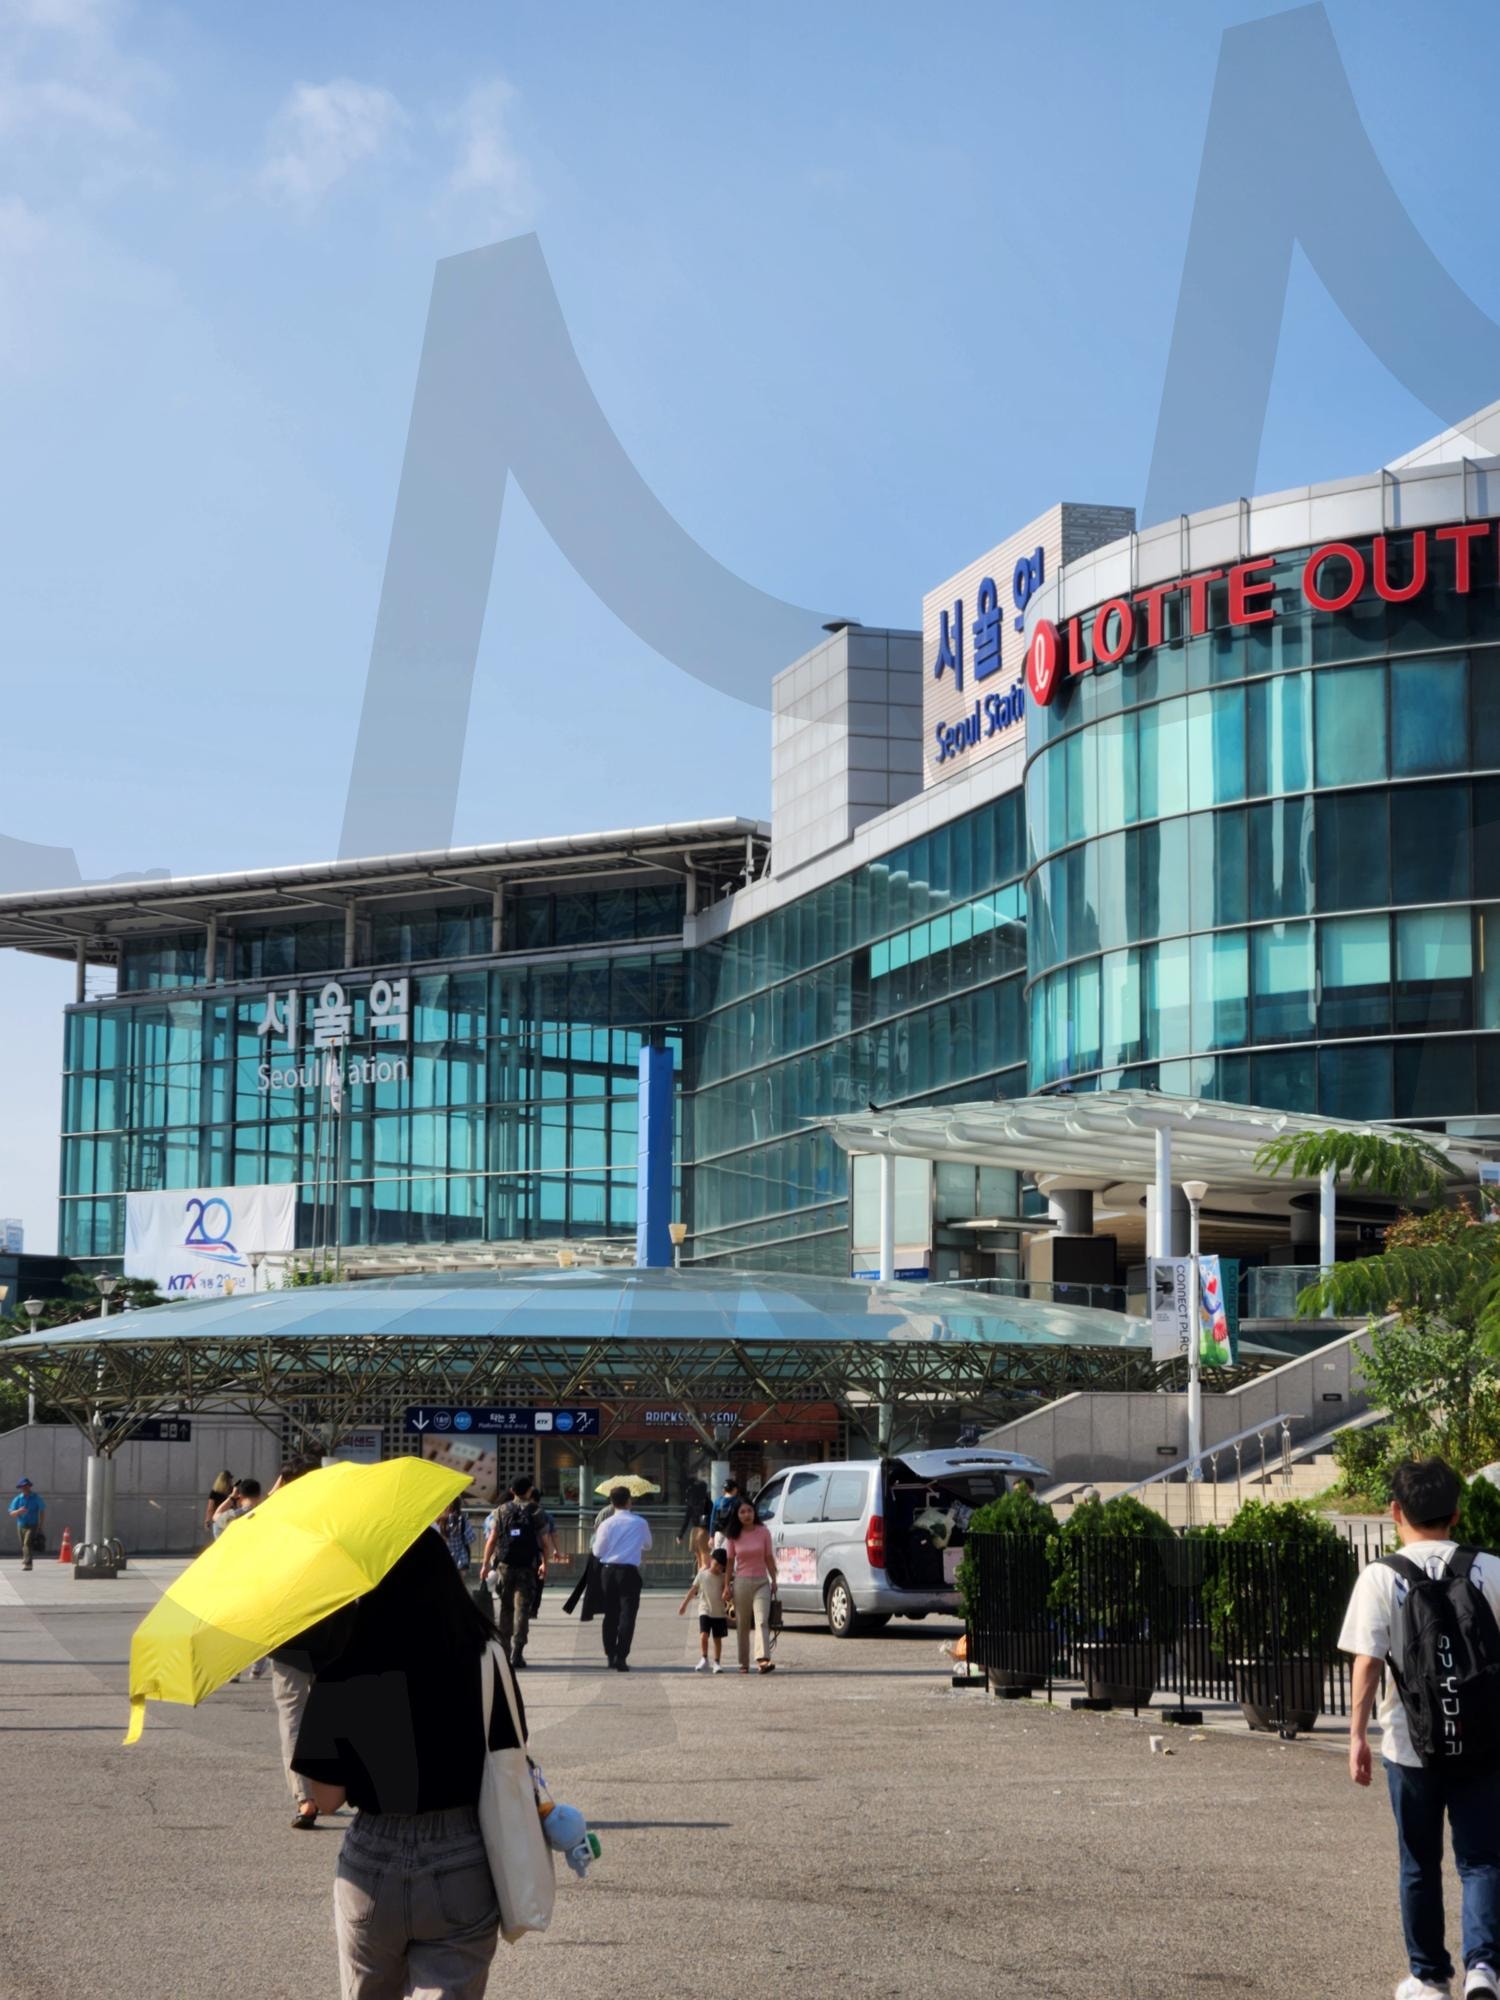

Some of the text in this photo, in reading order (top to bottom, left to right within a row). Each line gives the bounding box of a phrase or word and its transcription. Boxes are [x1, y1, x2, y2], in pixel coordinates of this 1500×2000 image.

[934, 547, 1044, 692] 서울역
[1067, 522, 1500, 676] LOTTE OUT
[935, 678, 1025, 764] Seoul Stati
[257, 978, 409, 1050] 서울역
[257, 1055, 409, 1091] Seoul ation
[185, 1197, 234, 1248] 20
[168, 1271, 202, 1290] KTX
[1178, 1321, 1189, 1352] PLAC
[490, 1413, 517, 1424] 타는 곳
